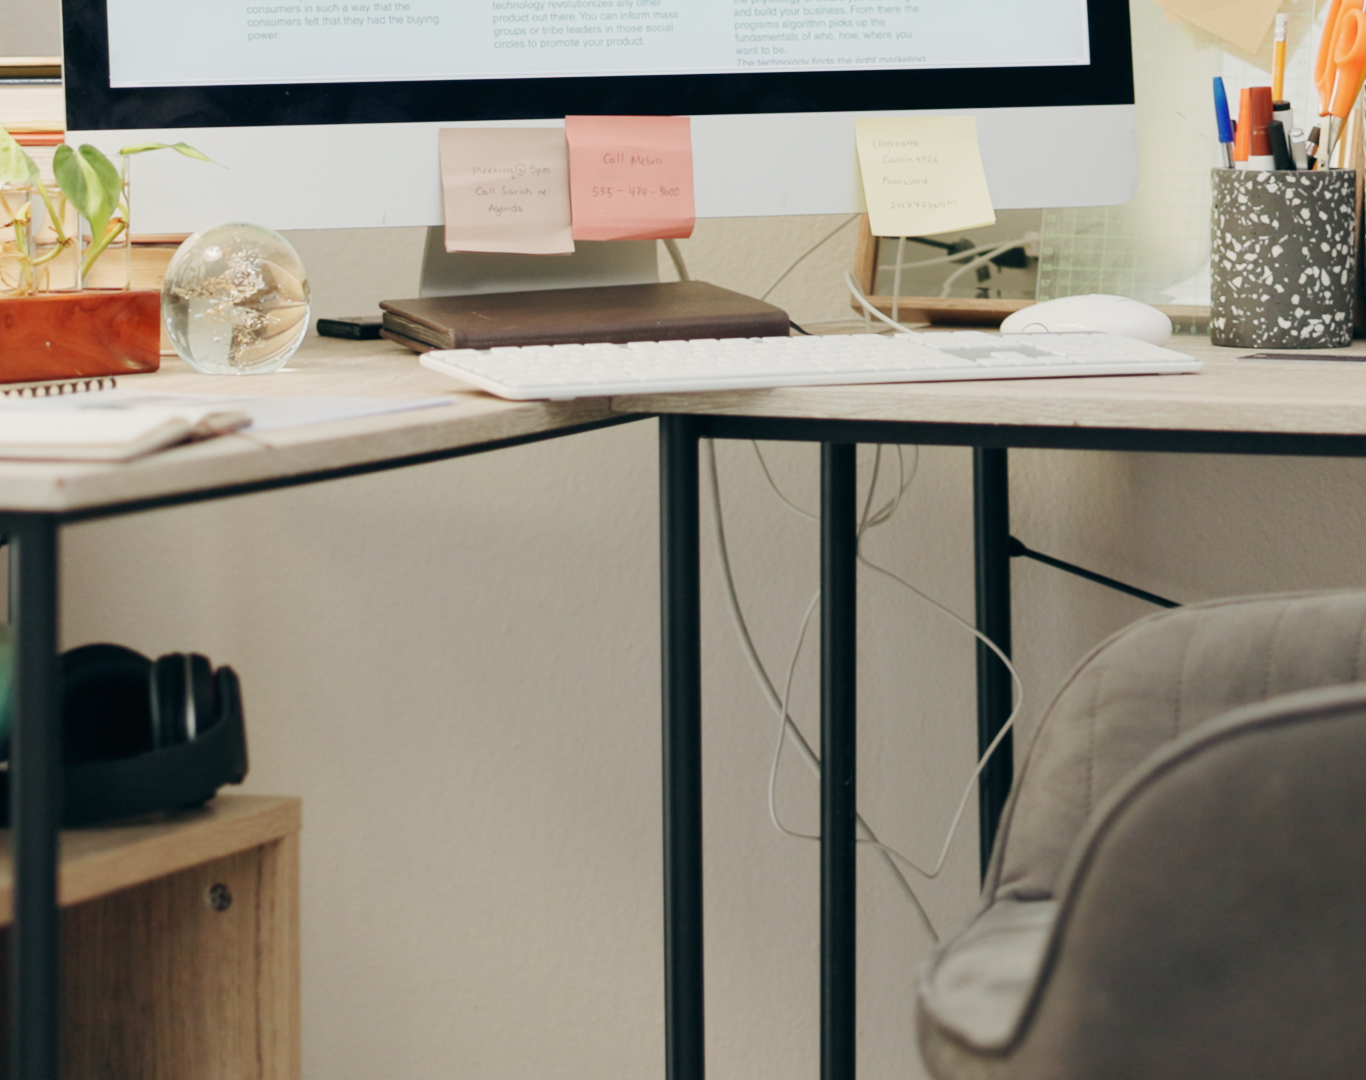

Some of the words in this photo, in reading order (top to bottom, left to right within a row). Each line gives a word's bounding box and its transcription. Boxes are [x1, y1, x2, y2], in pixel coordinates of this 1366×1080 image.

[603, 152, 625, 164] Call
[475, 186, 496, 196] Call
[501, 186, 533, 196] Sarah
[591, 186, 614, 198] 555
[488, 203, 524, 217] Agenda
